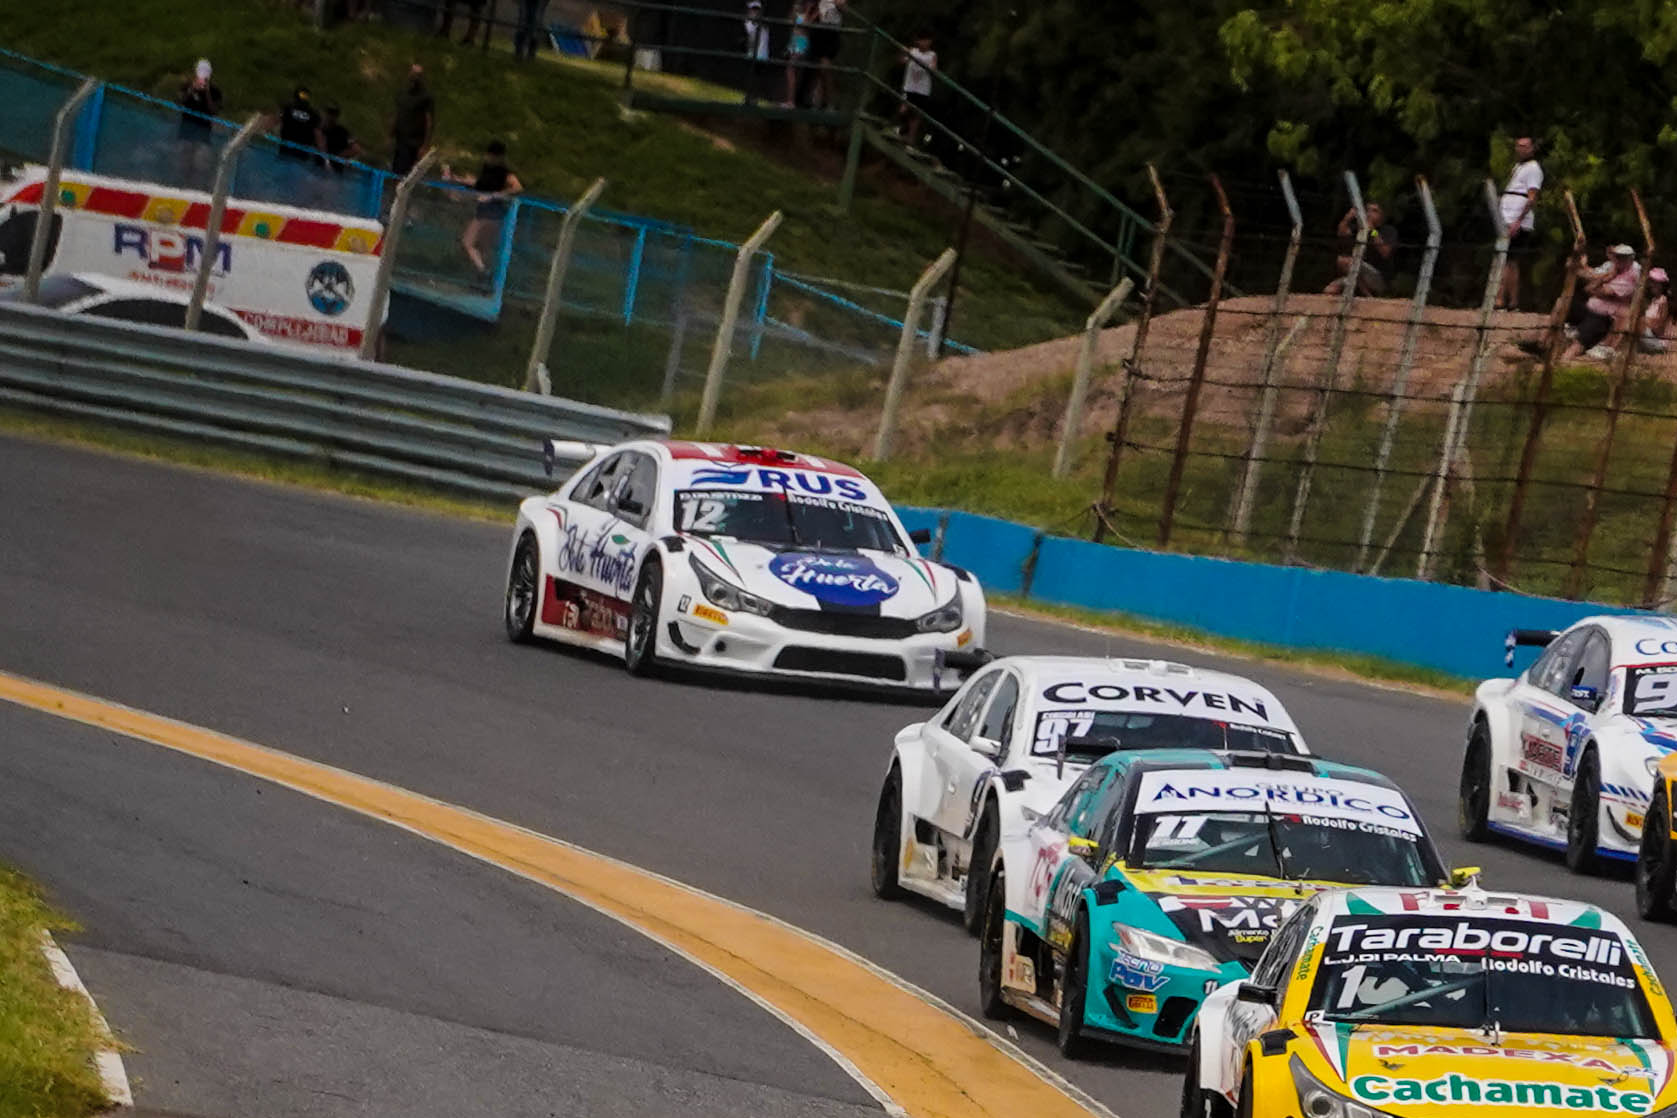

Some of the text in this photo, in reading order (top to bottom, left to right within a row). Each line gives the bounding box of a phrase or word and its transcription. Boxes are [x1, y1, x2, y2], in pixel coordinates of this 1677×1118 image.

[756, 469, 867, 501] RUS
[681, 500, 726, 532] 12
[1043, 682, 1270, 722] CORVEN
[1152, 815, 1209, 839] 11
[1302, 815, 1417, 843] Rodolfo Cristales
[1331, 922, 1621, 966] Taraborelli
[1386, 953, 1460, 964] PALMA
[1336, 965, 1367, 1009] 1
[1558, 966, 1636, 989] Cristales
[1376, 1045, 1617, 1072] MADEXA
[1353, 1073, 1650, 1113] Cachamate
